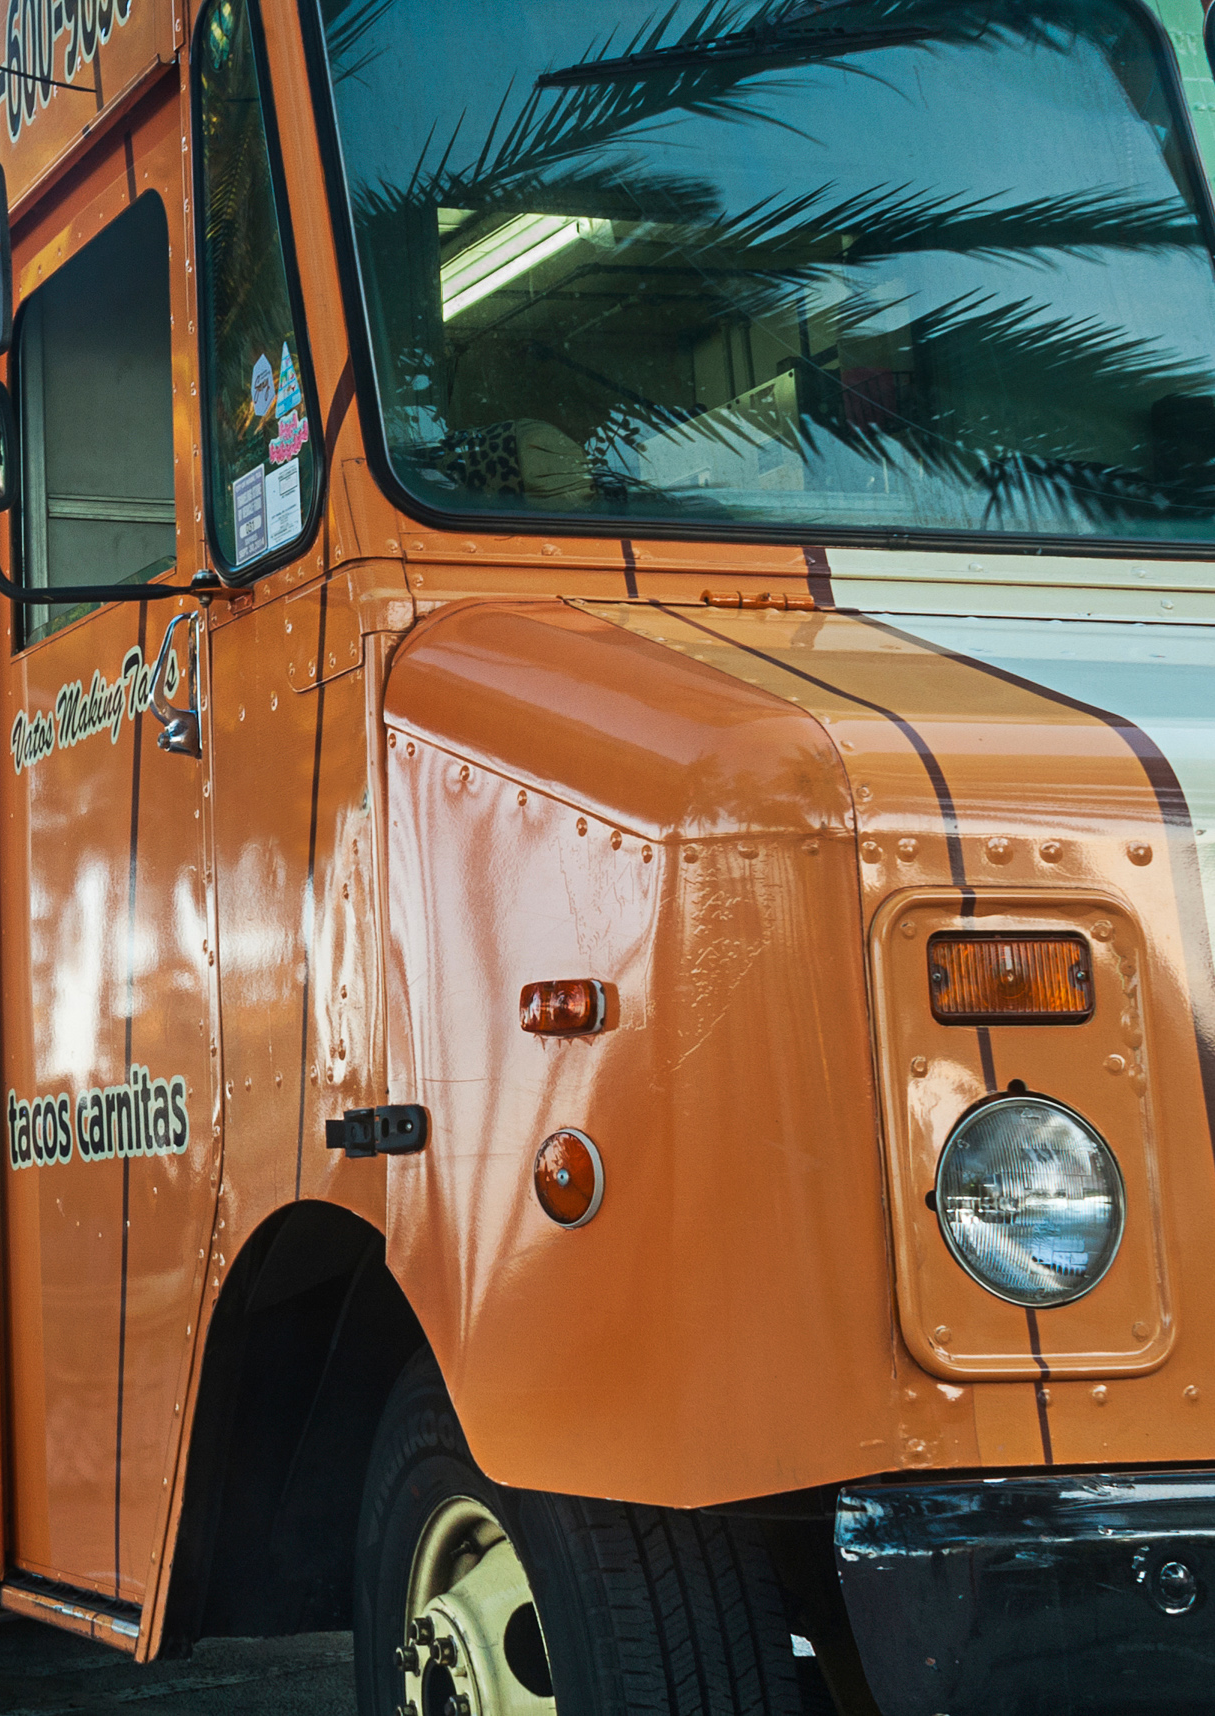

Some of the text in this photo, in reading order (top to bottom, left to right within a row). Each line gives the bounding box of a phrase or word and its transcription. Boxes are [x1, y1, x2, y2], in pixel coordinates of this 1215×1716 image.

[12, 646, 178, 774] Vatos Making Tas
[9, 1092, 72, 1168] tacos
[78, 1066, 187, 1160] carnitas
